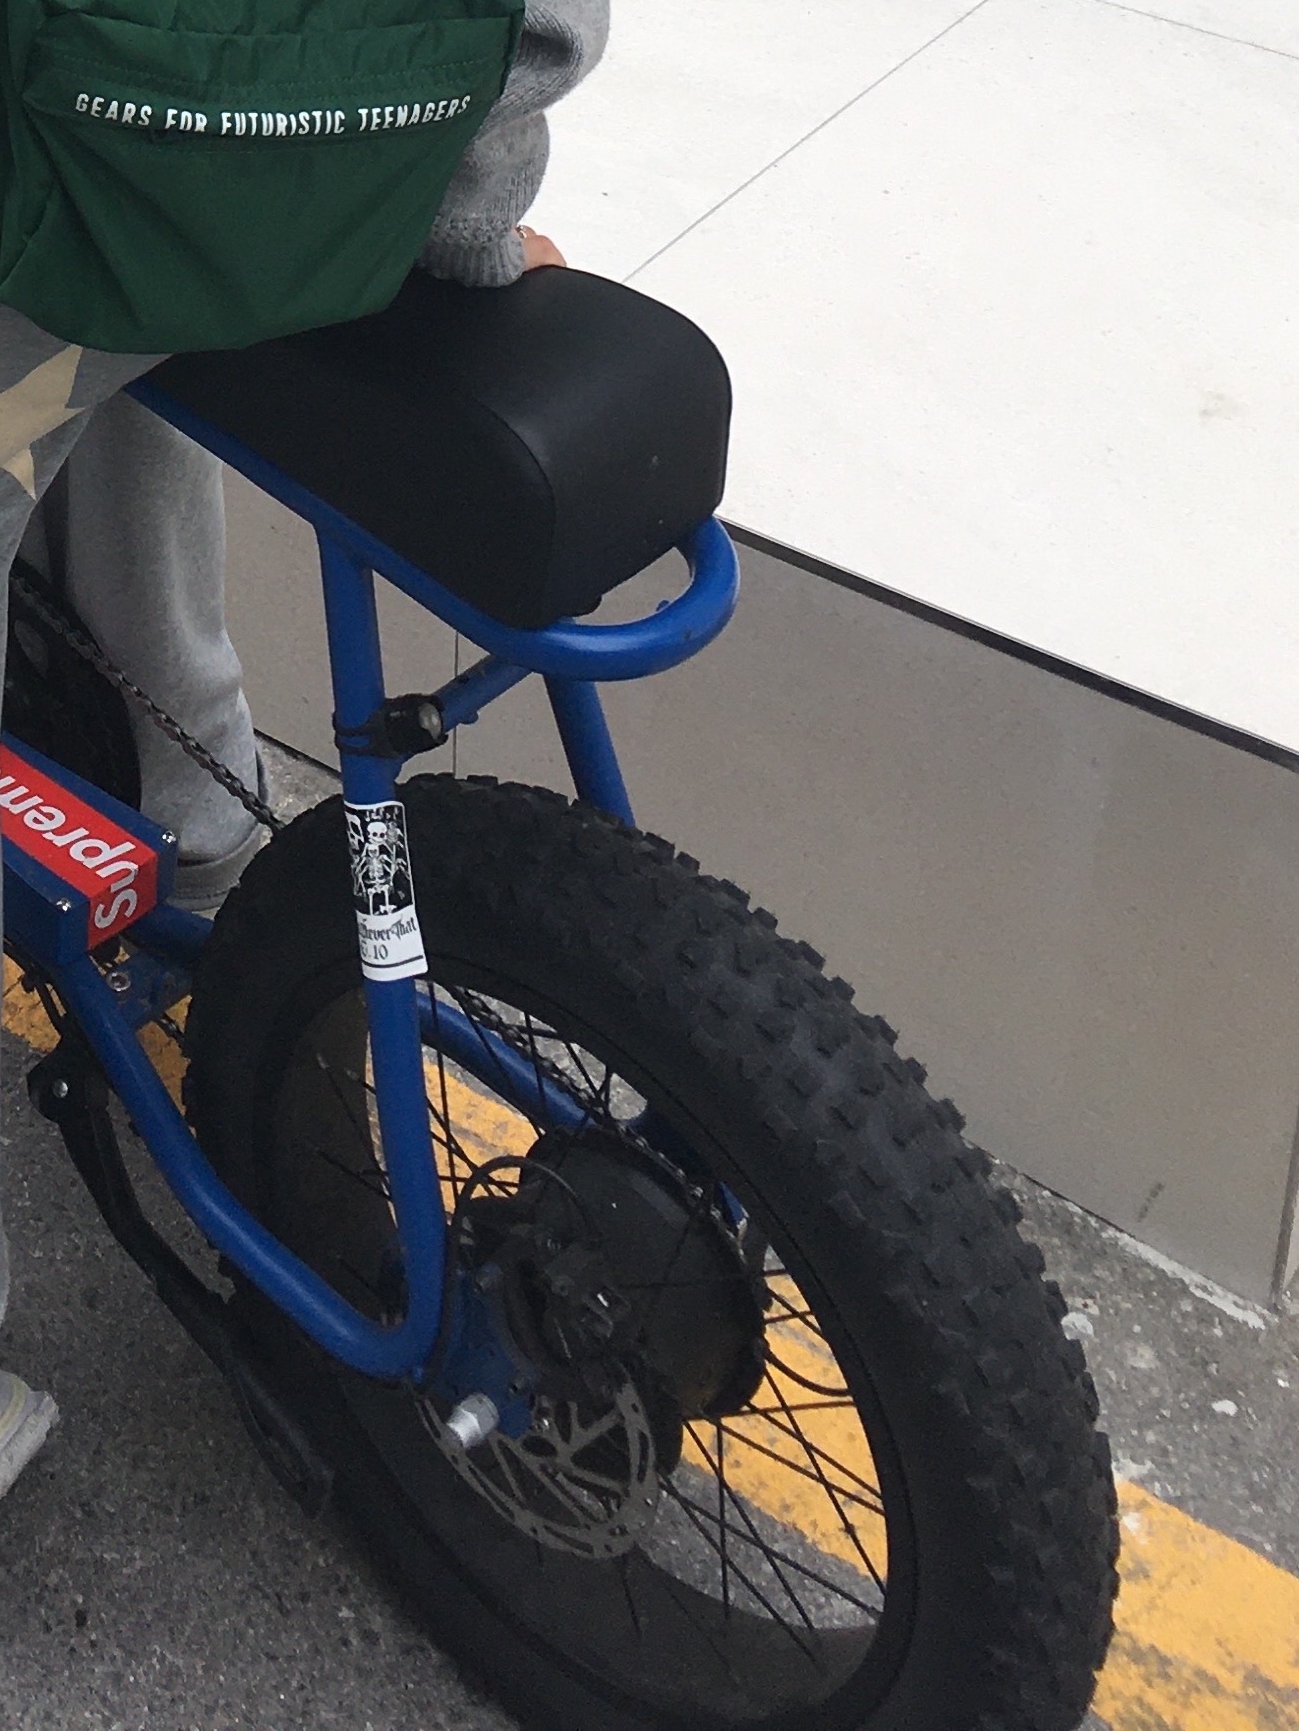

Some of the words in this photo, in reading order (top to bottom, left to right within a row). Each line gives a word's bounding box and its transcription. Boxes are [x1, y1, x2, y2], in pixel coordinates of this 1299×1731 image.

[75, 93, 153, 126] GEARS
[164, 108, 208, 133] FOR
[220, 111, 346, 137] FUTURISTIC
[357, 94, 471, 132] TEENAGERS
